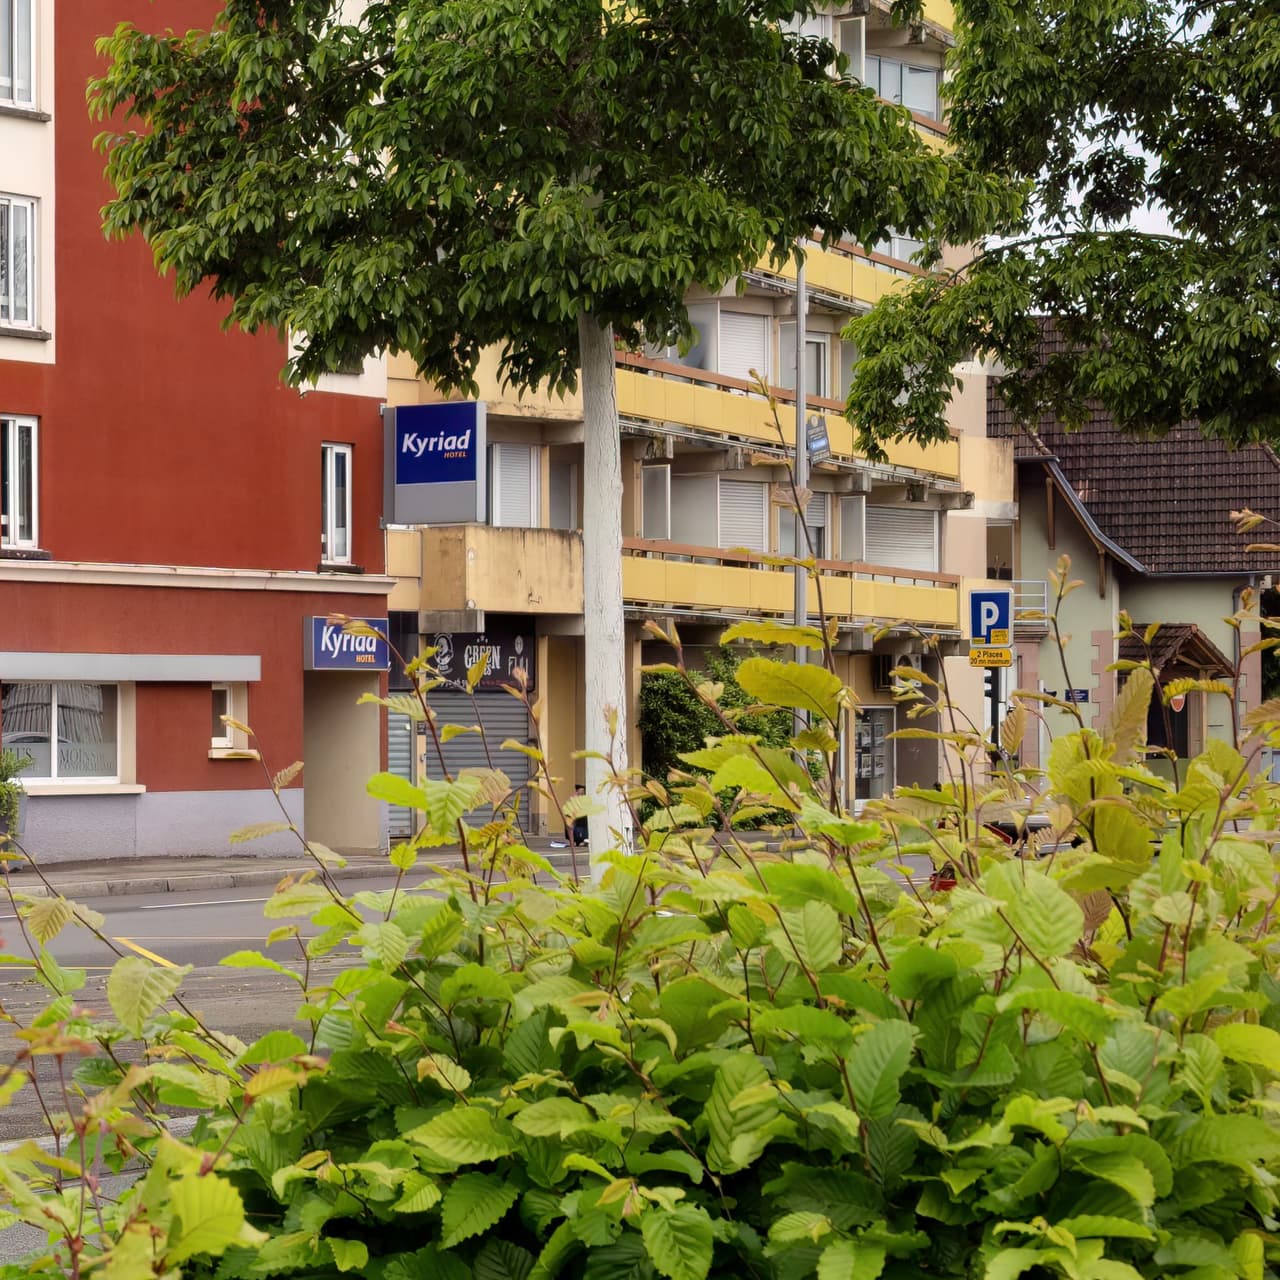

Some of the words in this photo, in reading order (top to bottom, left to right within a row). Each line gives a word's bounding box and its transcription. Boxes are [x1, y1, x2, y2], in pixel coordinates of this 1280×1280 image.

[402, 429, 472, 458] Kyriad
[444, 451, 468, 459] HOTEL
[980, 601, 1000, 636] P
[355, 654, 377, 663] HOTEL
